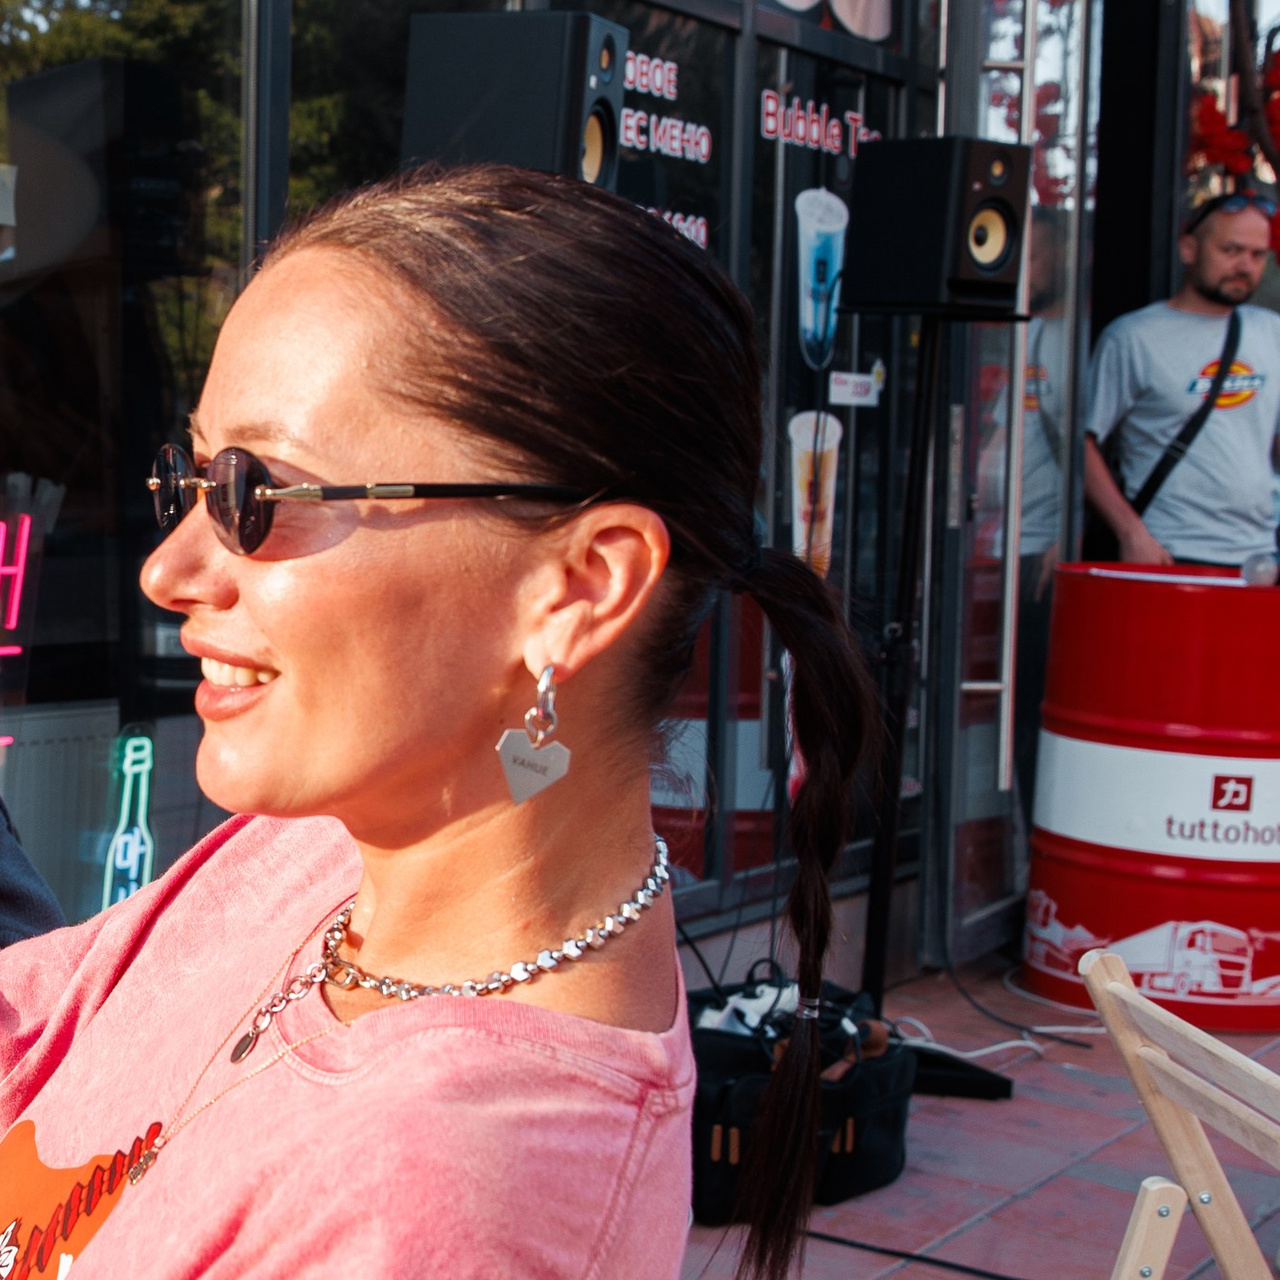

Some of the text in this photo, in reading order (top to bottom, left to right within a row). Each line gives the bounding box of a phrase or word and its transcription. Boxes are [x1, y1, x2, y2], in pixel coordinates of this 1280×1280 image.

[624, 51, 679, 100] ОВОЕ
[649, 115, 712, 163] МЕНЮ
[762, 89, 843, 154] Bubble
